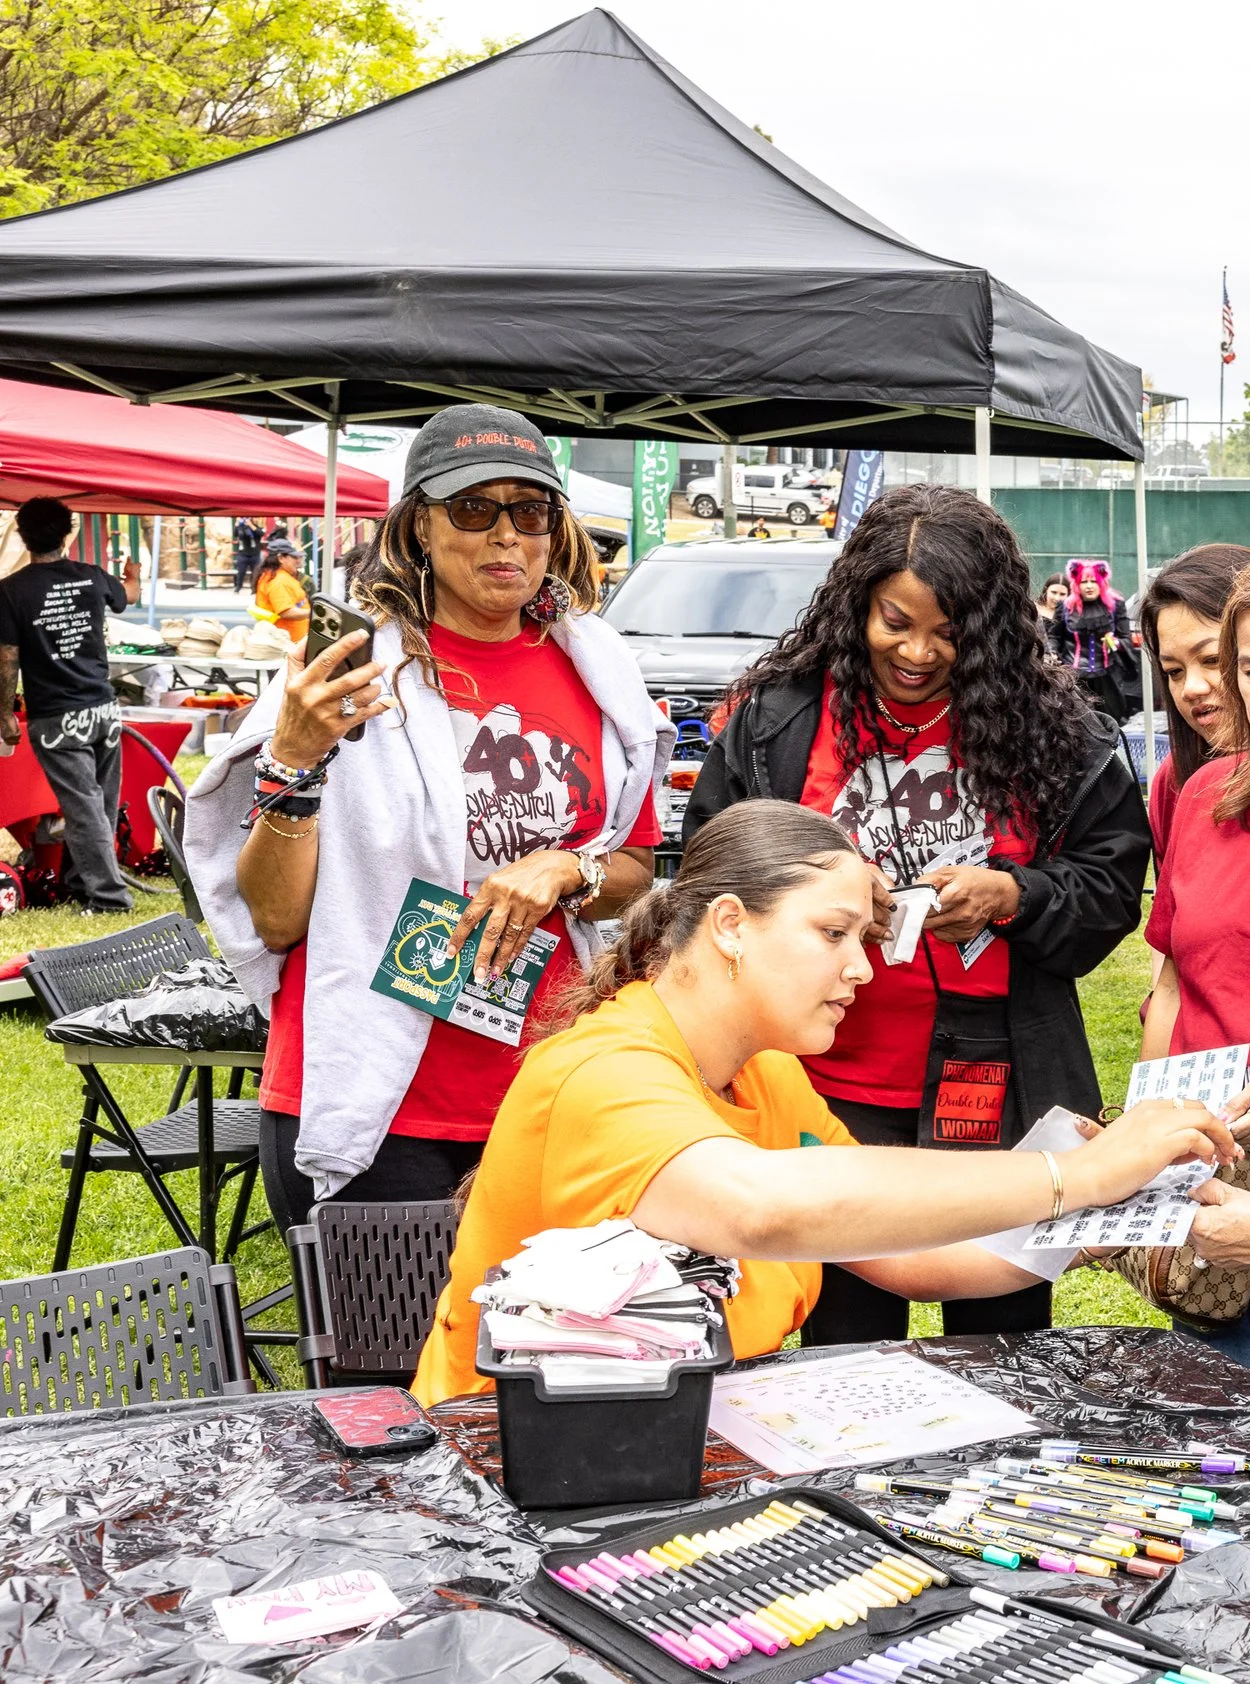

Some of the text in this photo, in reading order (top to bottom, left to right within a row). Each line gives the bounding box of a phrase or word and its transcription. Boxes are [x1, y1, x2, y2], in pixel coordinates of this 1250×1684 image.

[455, 435, 473, 448] 40+
[475, 432, 511, 445] DOUBLE
[851, 450, 877, 517] DIEGO
[442, 900, 459, 910] 2025
[391, 976, 440, 1005] PASSPORT
[946, 1063, 1006, 1084] PHENOMENAL
[937, 1092, 973, 1108] Double
[941, 1119, 998, 1139] WOMAN
[1153, 1461, 1181, 1469] MARKER
